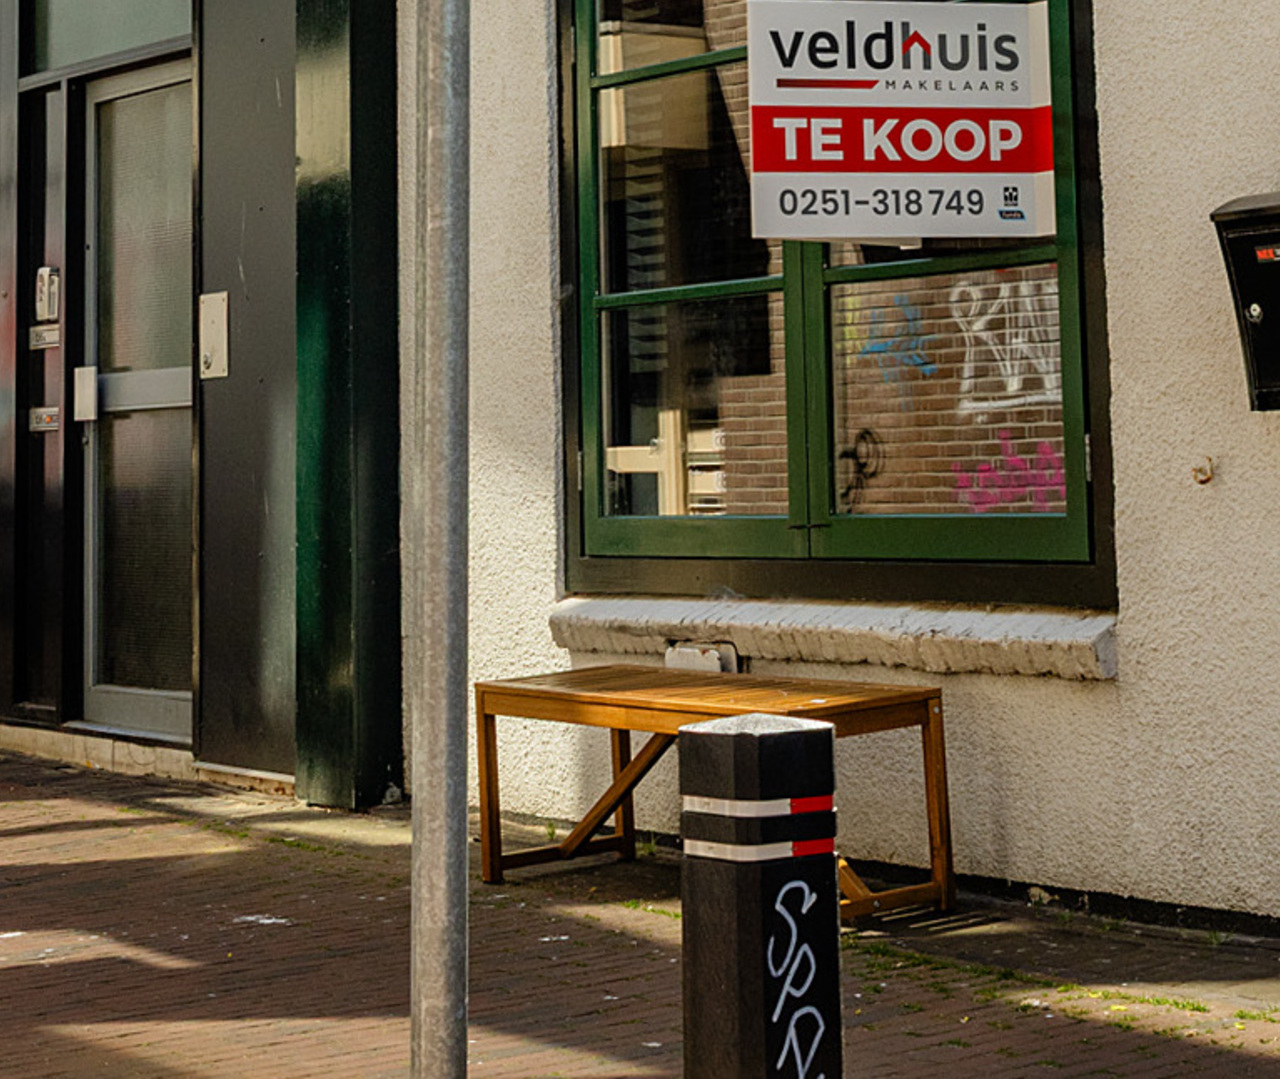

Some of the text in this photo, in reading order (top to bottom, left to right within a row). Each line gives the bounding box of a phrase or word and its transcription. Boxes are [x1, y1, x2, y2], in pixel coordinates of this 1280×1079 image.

[769, 20, 1020, 72] veldhuis
[884, 79, 1019, 92] MAKELAARS
[773, 117, 1023, 162] TE KOOP
